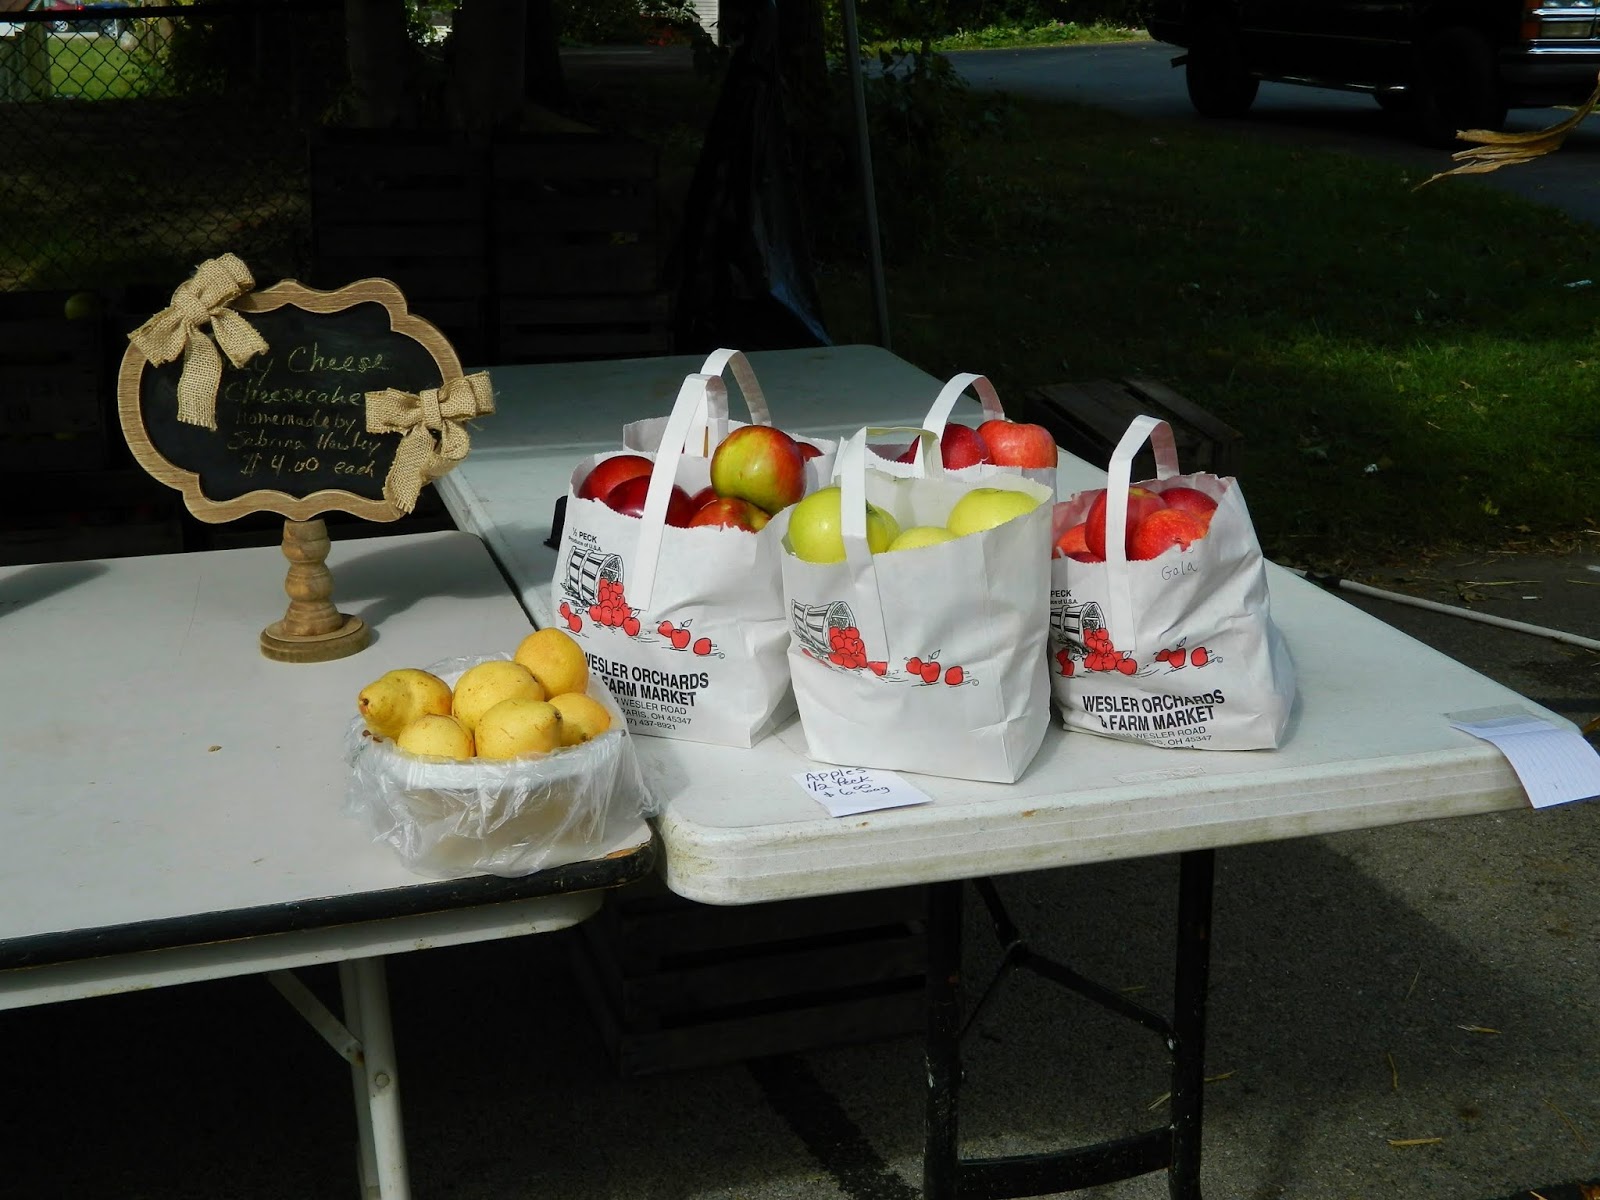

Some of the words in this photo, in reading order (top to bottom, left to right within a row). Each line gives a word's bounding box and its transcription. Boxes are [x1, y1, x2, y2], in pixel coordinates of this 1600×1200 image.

[288, 342, 390, 373] Cheese
[334, 459, 375, 478] each
[579, 531, 598, 544] PECK
[1161, 560, 1198, 581] Gala
[1050, 589, 1072, 598] PECK
[632, 666, 709, 690] ORCHARDS
[641, 684, 697, 707] MARKET
[1082, 694, 1139, 713] WESLER
[1141, 689, 1225, 714] ORCHARDS
[621, 698, 658, 711] WESLER
[661, 704, 687, 715] ROAD
[651, 712, 665, 721] OH
[666, 714, 692, 725] 45347
[1109, 714, 1150, 731] FARM
[1152, 704, 1215, 731] MARKET
[1178, 726, 1206, 737] ROAD
[805, 767, 867, 782] Apples
